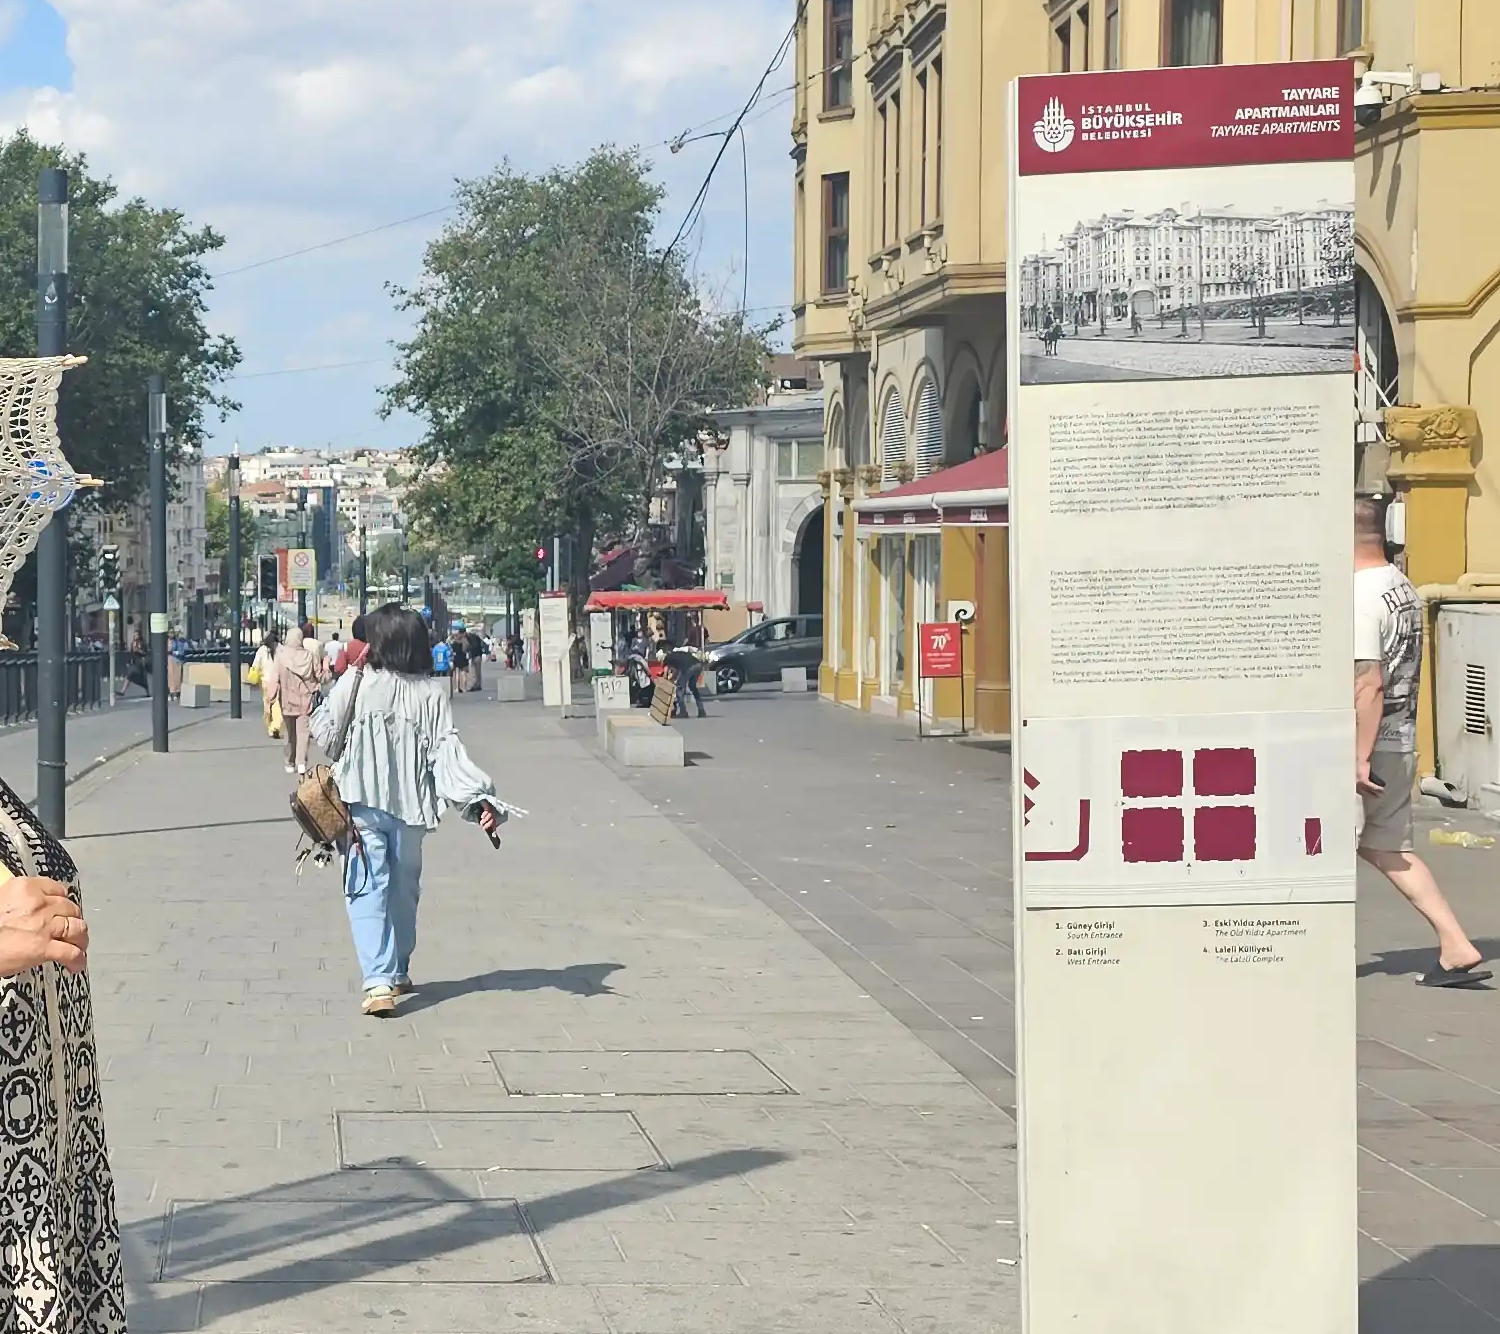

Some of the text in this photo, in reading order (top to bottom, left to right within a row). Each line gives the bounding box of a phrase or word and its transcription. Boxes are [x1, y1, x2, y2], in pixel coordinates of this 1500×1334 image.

[1282, 87, 1340, 100] TAYYARE
[1081, 102, 1152, 115] İSTANBUL
[1235, 104, 1340, 120] APARTMANLARI
[1081, 110, 1183, 130] BÜYÜKŞEHİR
[1210, 120, 1341, 137] TAYYARE APARTMENTS
[1081, 128, 1152, 141] BELEDİYESİ
[1067, 921, 1092, 931] Güney
[1202, 919, 1300, 928] 3. Eski Yıldız Apartmanı
[1067, 931, 1123, 939] South Entrance
[1215, 929, 1229, 937] The
[1266, 928, 1307, 937] Apartment
[1238, 944, 1273, 954] Külliyesi
[1087, 957, 1120, 965] Entrance
[1252, 954, 1285, 964] Complex
